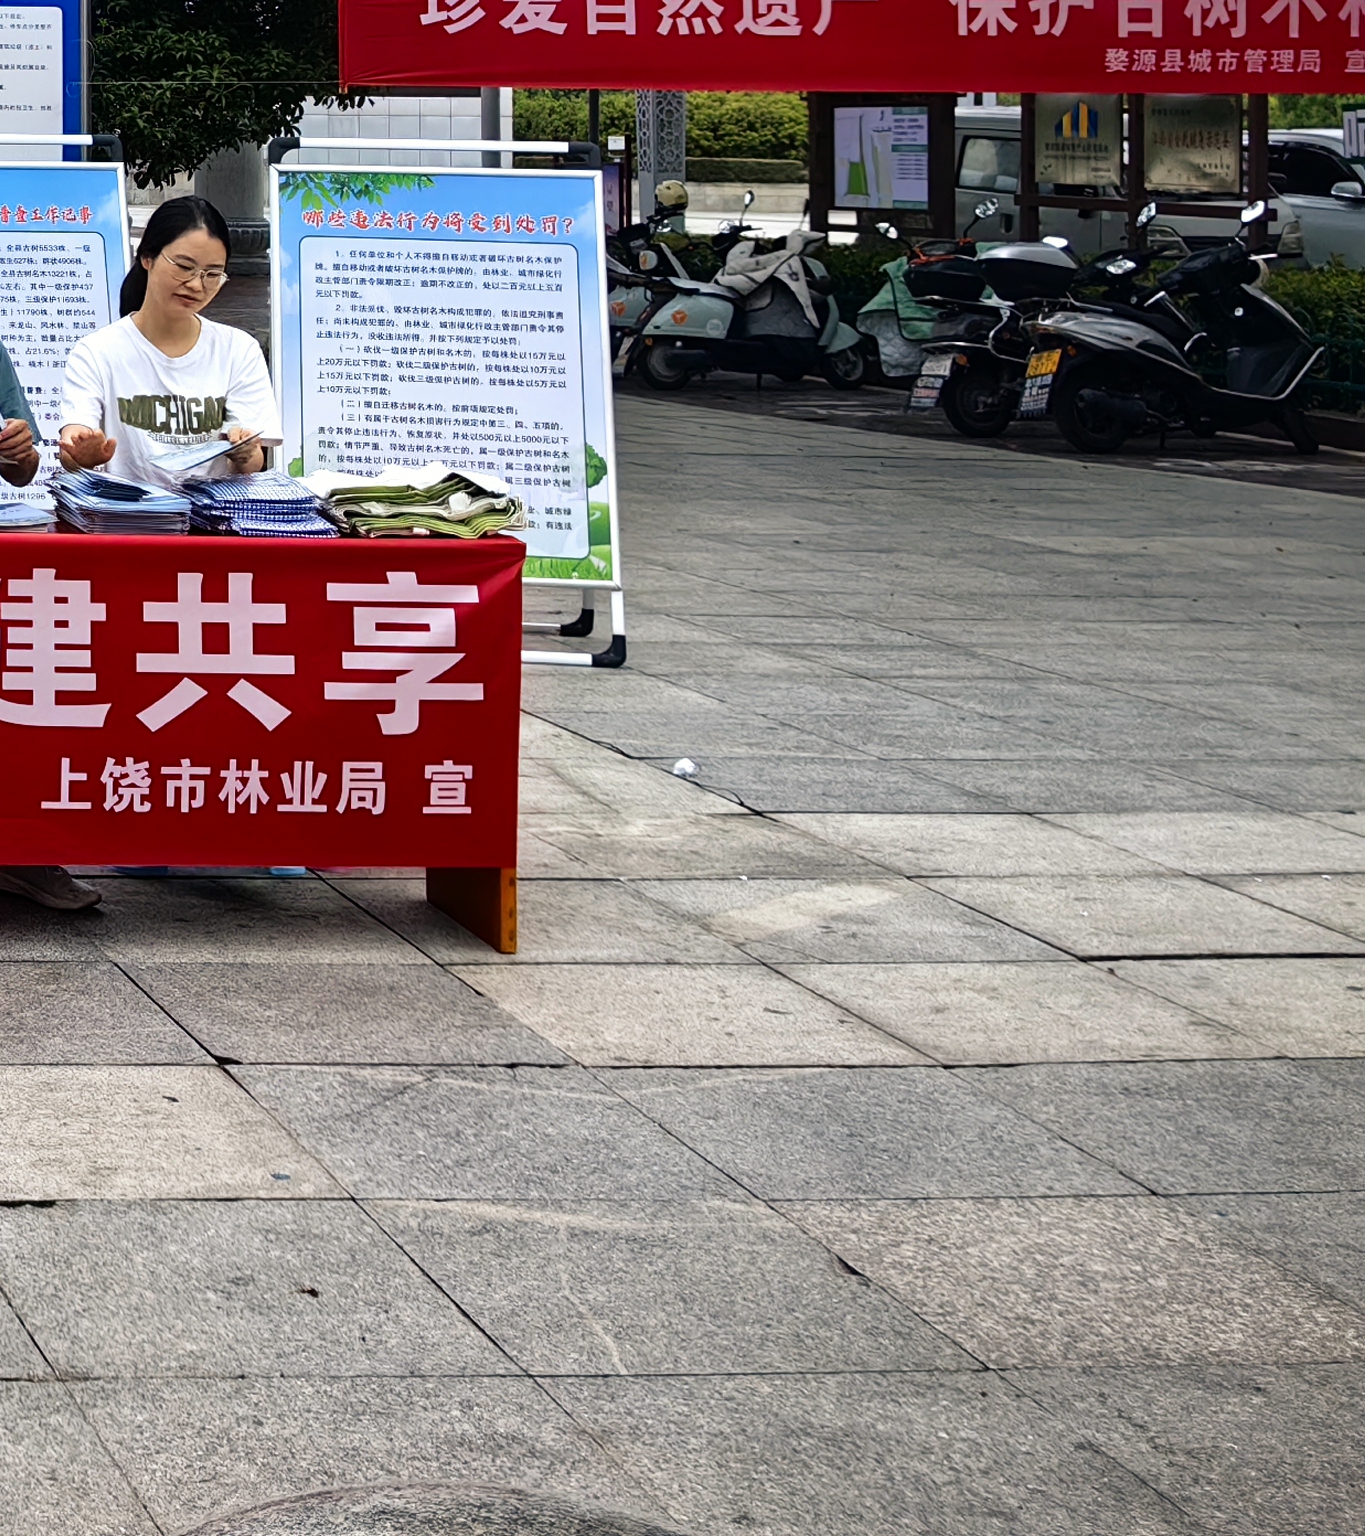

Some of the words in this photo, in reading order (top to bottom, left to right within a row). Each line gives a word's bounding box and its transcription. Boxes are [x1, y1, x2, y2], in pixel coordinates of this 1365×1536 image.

[1104, 48, 1321, 74] 婺源县城市管理局
[1344, 49, 1365, 73] 宣
[40, 756, 386, 815] 上饶市林业局
[422, 759, 473, 814] 宣
